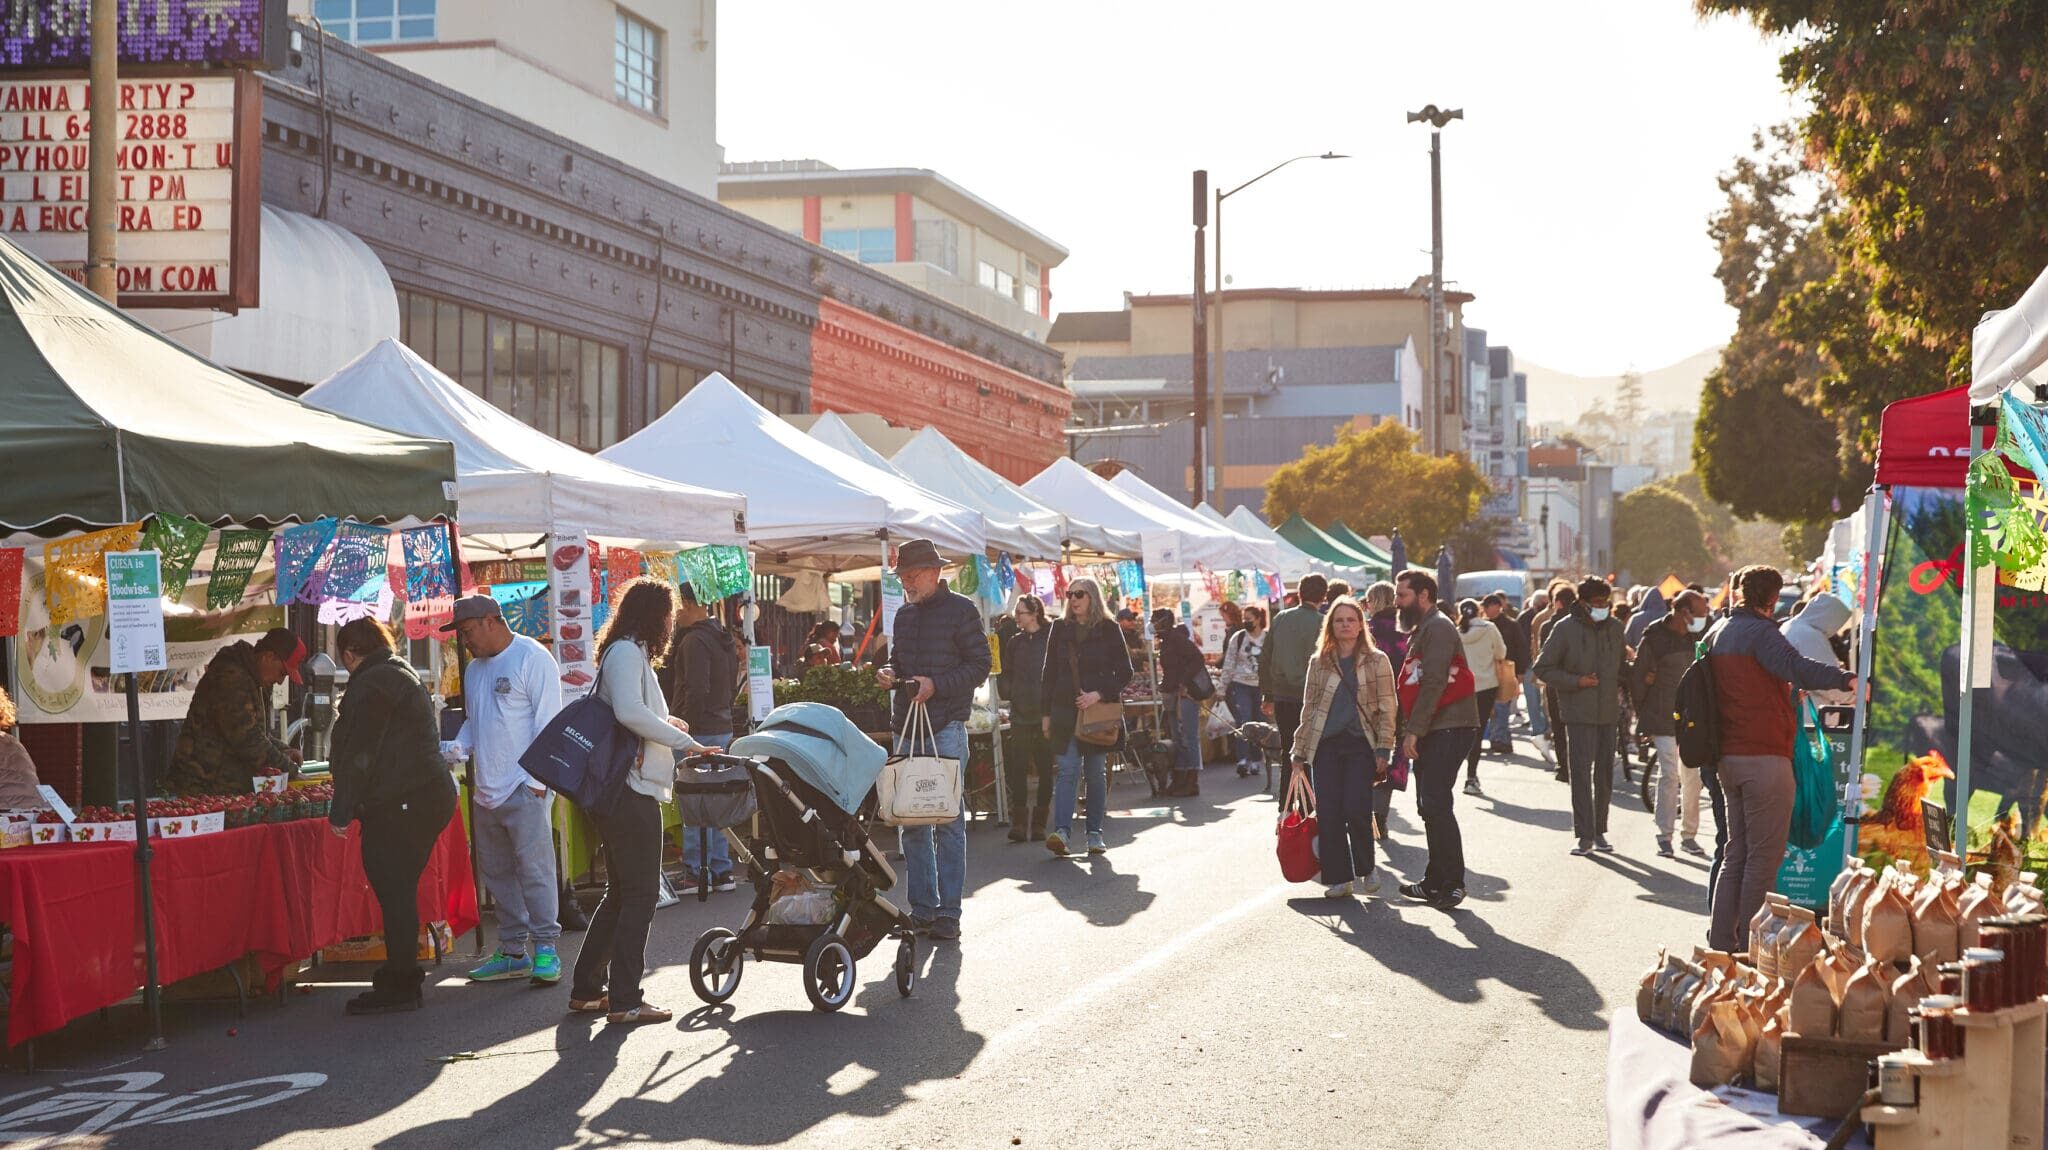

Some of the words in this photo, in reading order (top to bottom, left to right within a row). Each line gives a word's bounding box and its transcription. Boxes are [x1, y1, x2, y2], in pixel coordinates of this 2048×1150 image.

[0, 86, 70, 111] ANNA
[66, 115, 90, 140] 64
[125, 114, 186, 140] 2888
[0, 145, 86, 171] PYHOU
[150, 175, 186, 201] PM
[161, 266, 217, 291] COM
[110, 558, 133, 569] CUESA
[135, 558, 144, 569] is
[112, 582, 151, 595] Foodwise.
[564, 726, 594, 750] BELCAMP
